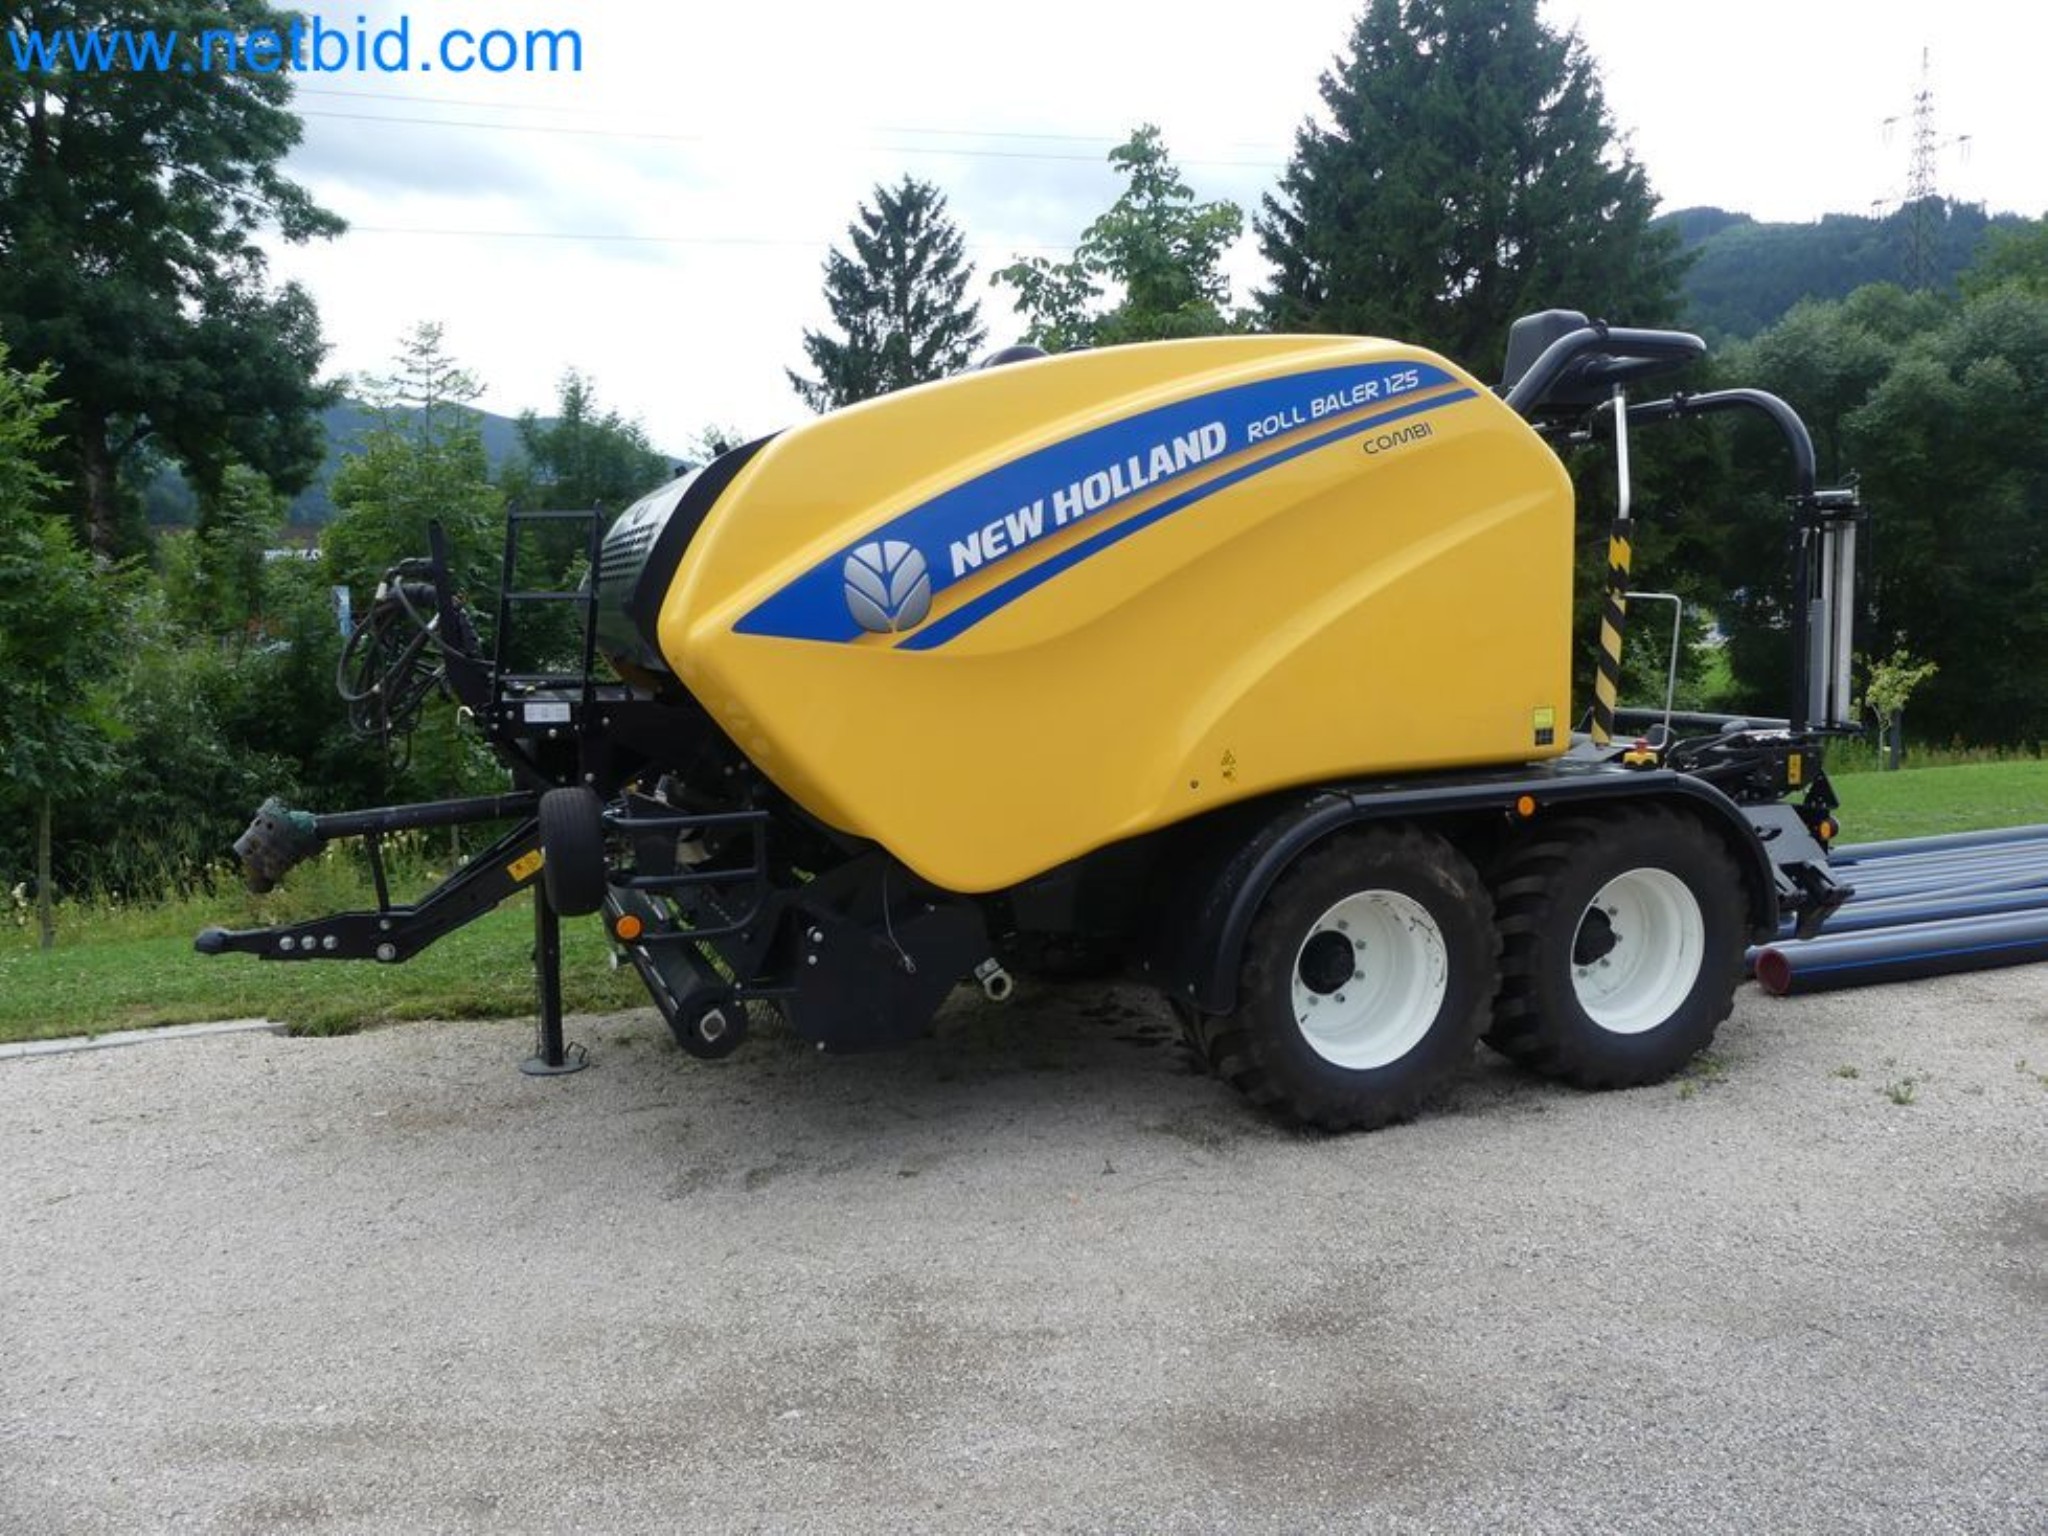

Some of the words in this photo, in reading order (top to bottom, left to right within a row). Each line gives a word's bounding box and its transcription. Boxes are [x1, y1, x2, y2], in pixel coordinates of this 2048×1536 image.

[1247, 407, 1305, 443] ROLL
[1310, 381, 1380, 419] BALER
[1383, 369, 1420, 395] 125
[1363, 422, 1434, 455] COMBI
[950, 500, 1044, 577] NEW
[1052, 421, 1226, 526] HOLLAND
